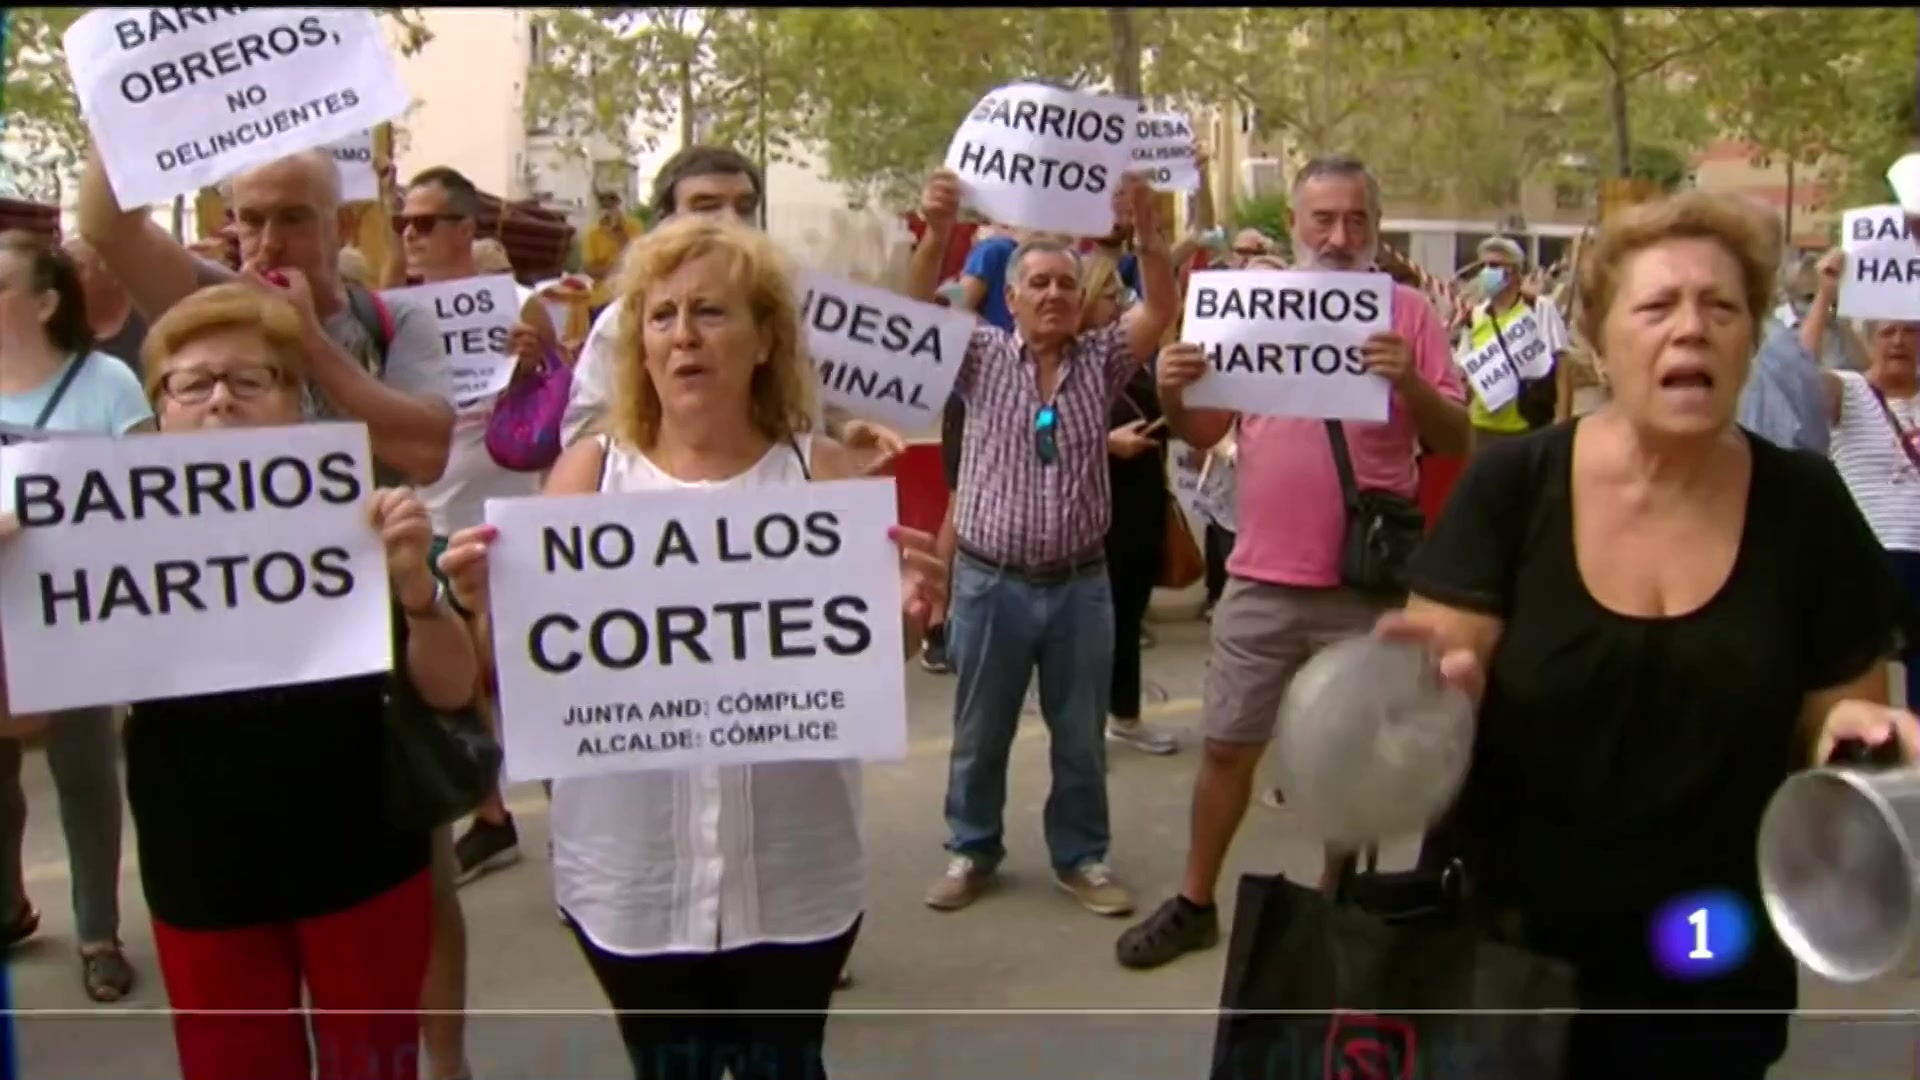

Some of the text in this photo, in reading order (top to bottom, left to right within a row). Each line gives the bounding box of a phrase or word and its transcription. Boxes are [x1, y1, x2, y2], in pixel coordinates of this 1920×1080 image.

[120, 16, 341, 103] OBREROS,
[226, 84, 267, 113] NO
[156, 87, 360, 171] DELINCUENTES
[1135, 120, 1190, 138] DESA
[959, 141, 1107, 194] HARTOS
[434, 289, 495, 319] LOS
[1195, 287, 1379, 322] BARRIOS
[439, 325, 510, 356] TES
[14, 451, 361, 528] BARRIOS
[542, 510, 842, 574] NO A LOS
[39, 547, 355, 626] HARTOS
[528, 595, 872, 675] CORTES
[563, 703, 643, 726] JUNTA
